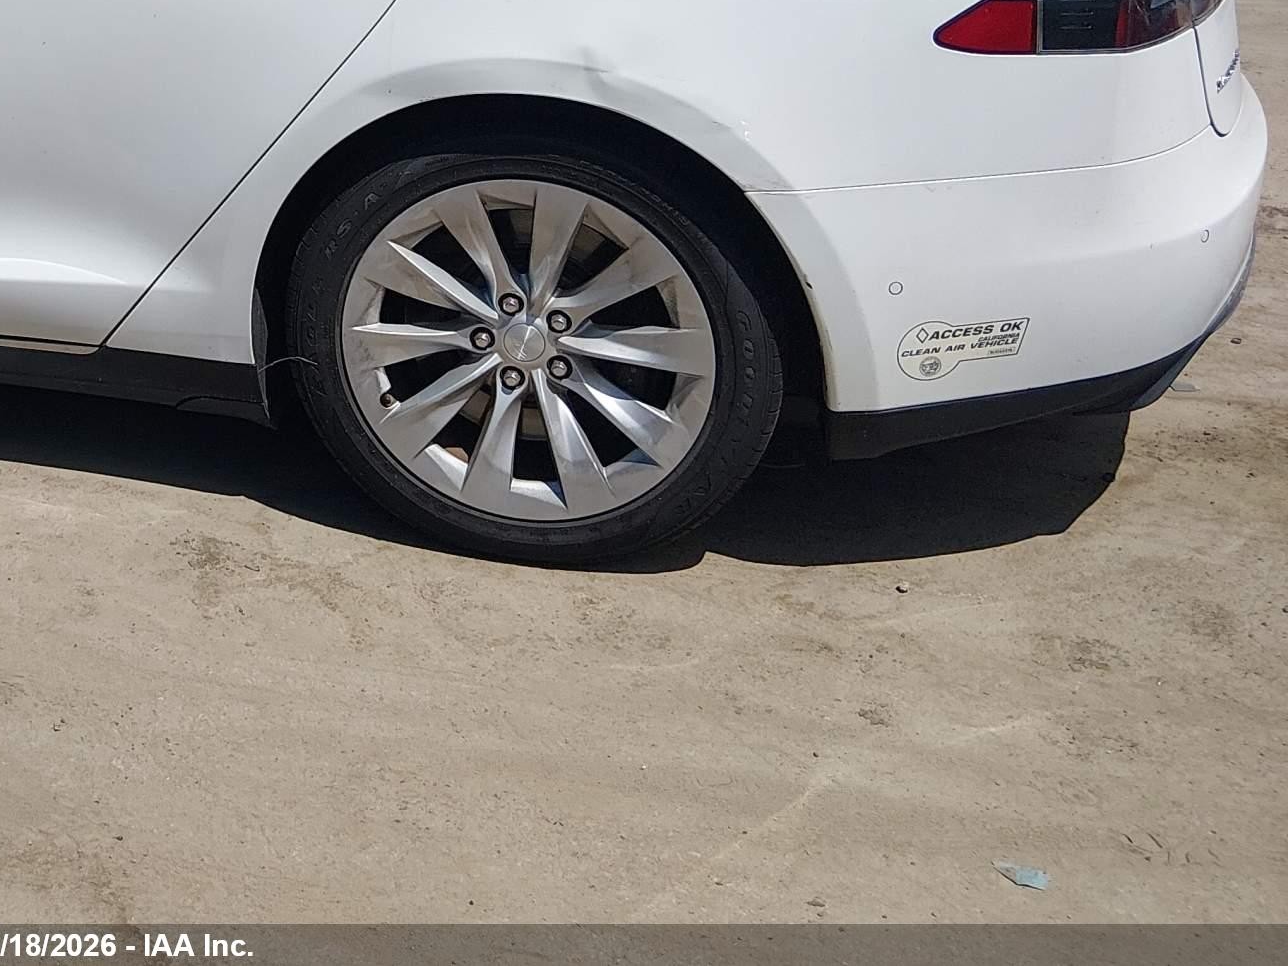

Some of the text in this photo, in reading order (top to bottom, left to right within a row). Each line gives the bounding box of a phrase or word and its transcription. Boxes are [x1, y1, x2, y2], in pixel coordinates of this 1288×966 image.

[928, 321, 1024, 341] ACCESS OK
[977, 332, 1020, 343] CALIFORNIA
[901, 338, 1019, 357] CLEAN AIR VEHICLE
